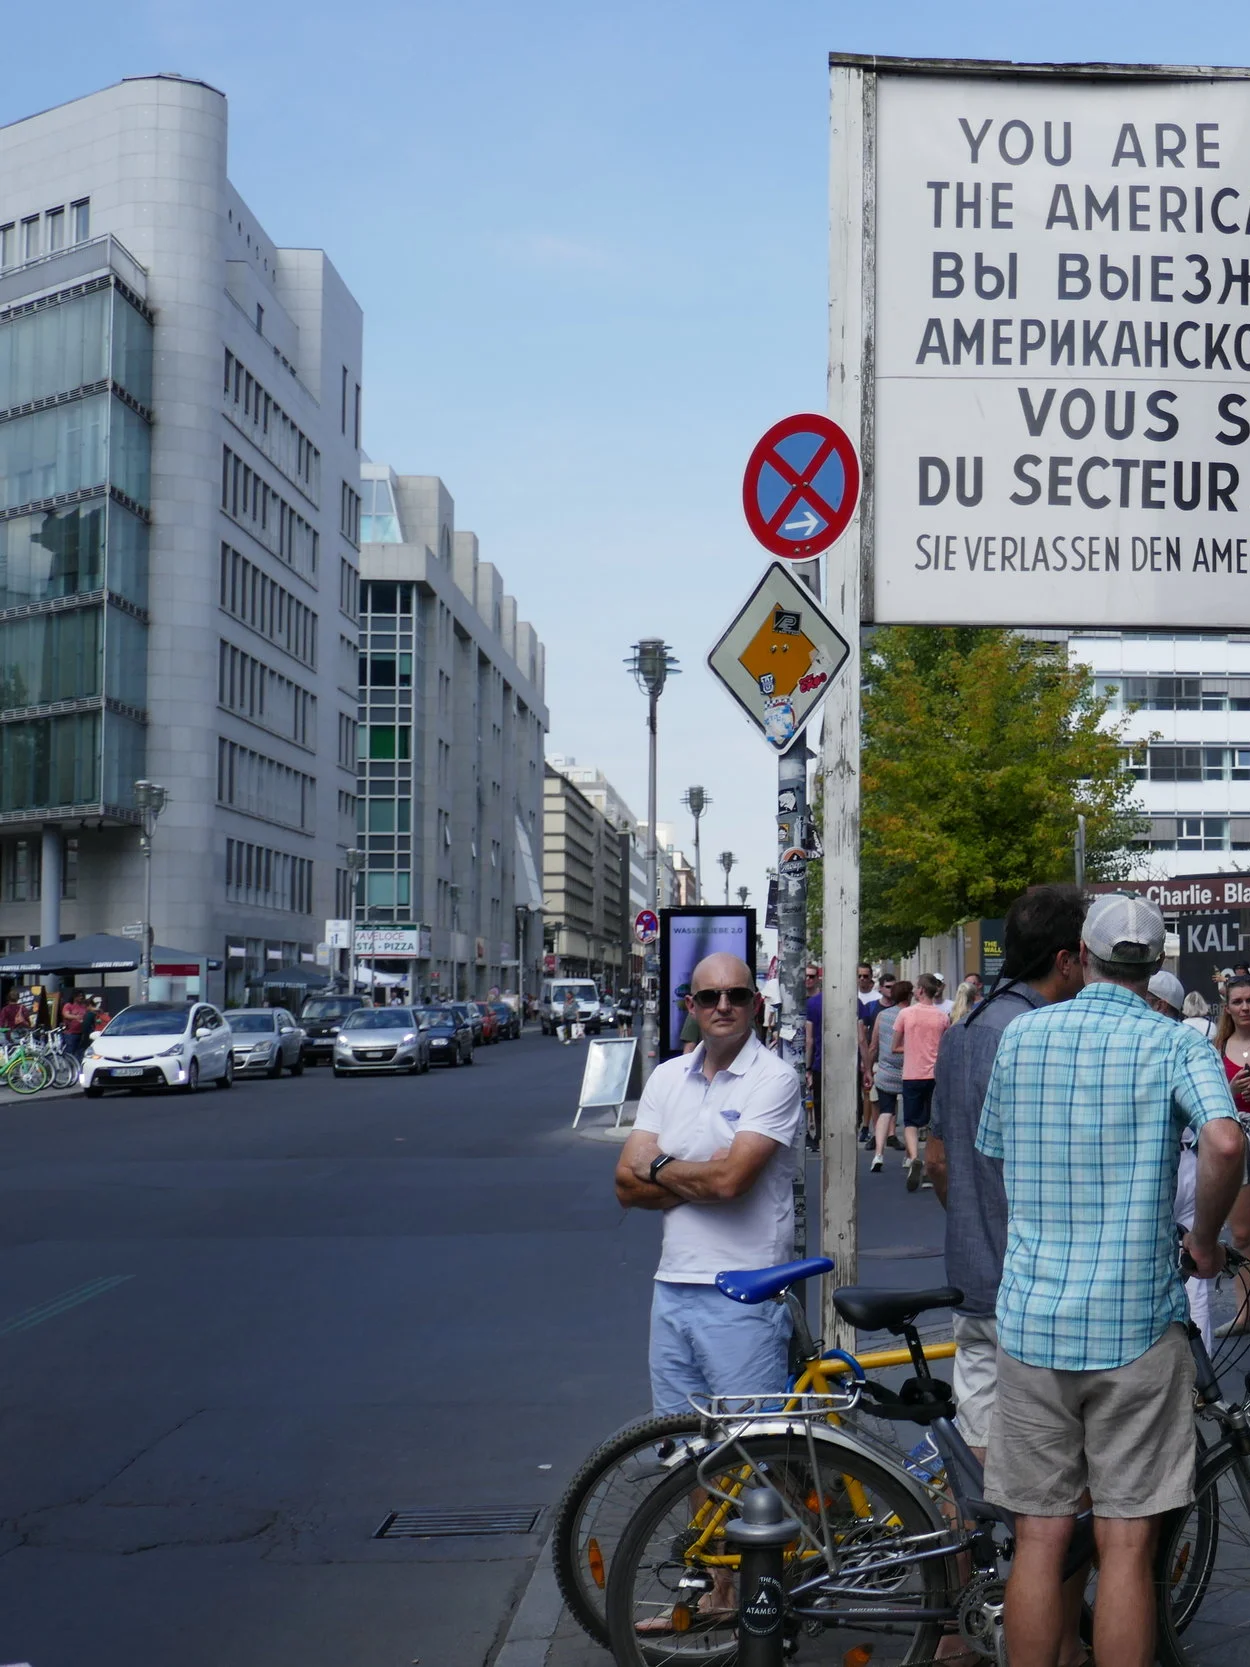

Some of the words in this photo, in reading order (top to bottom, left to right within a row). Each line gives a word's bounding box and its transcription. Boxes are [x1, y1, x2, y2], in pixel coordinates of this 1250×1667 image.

[959, 119, 1071, 166] YOU
[1112, 124, 1219, 168] ARE
[927, 182, 1012, 228] THE
[933, 252, 1017, 300] ВЫ
[1018, 388, 1179, 441] VOUS
[919, 457, 982, 507] DU
[1010, 455, 1239, 512] SECTEUR
[916, 535, 956, 570] SIE
[965, 537, 1119, 571] VERLASSEN
[1132, 537, 1180, 571] DEN
[1146, 883, 1212, 905] Charlie
[384, 942, 415, 951] PIZZA
[746, 1606, 778, 1615] ATAMEO
